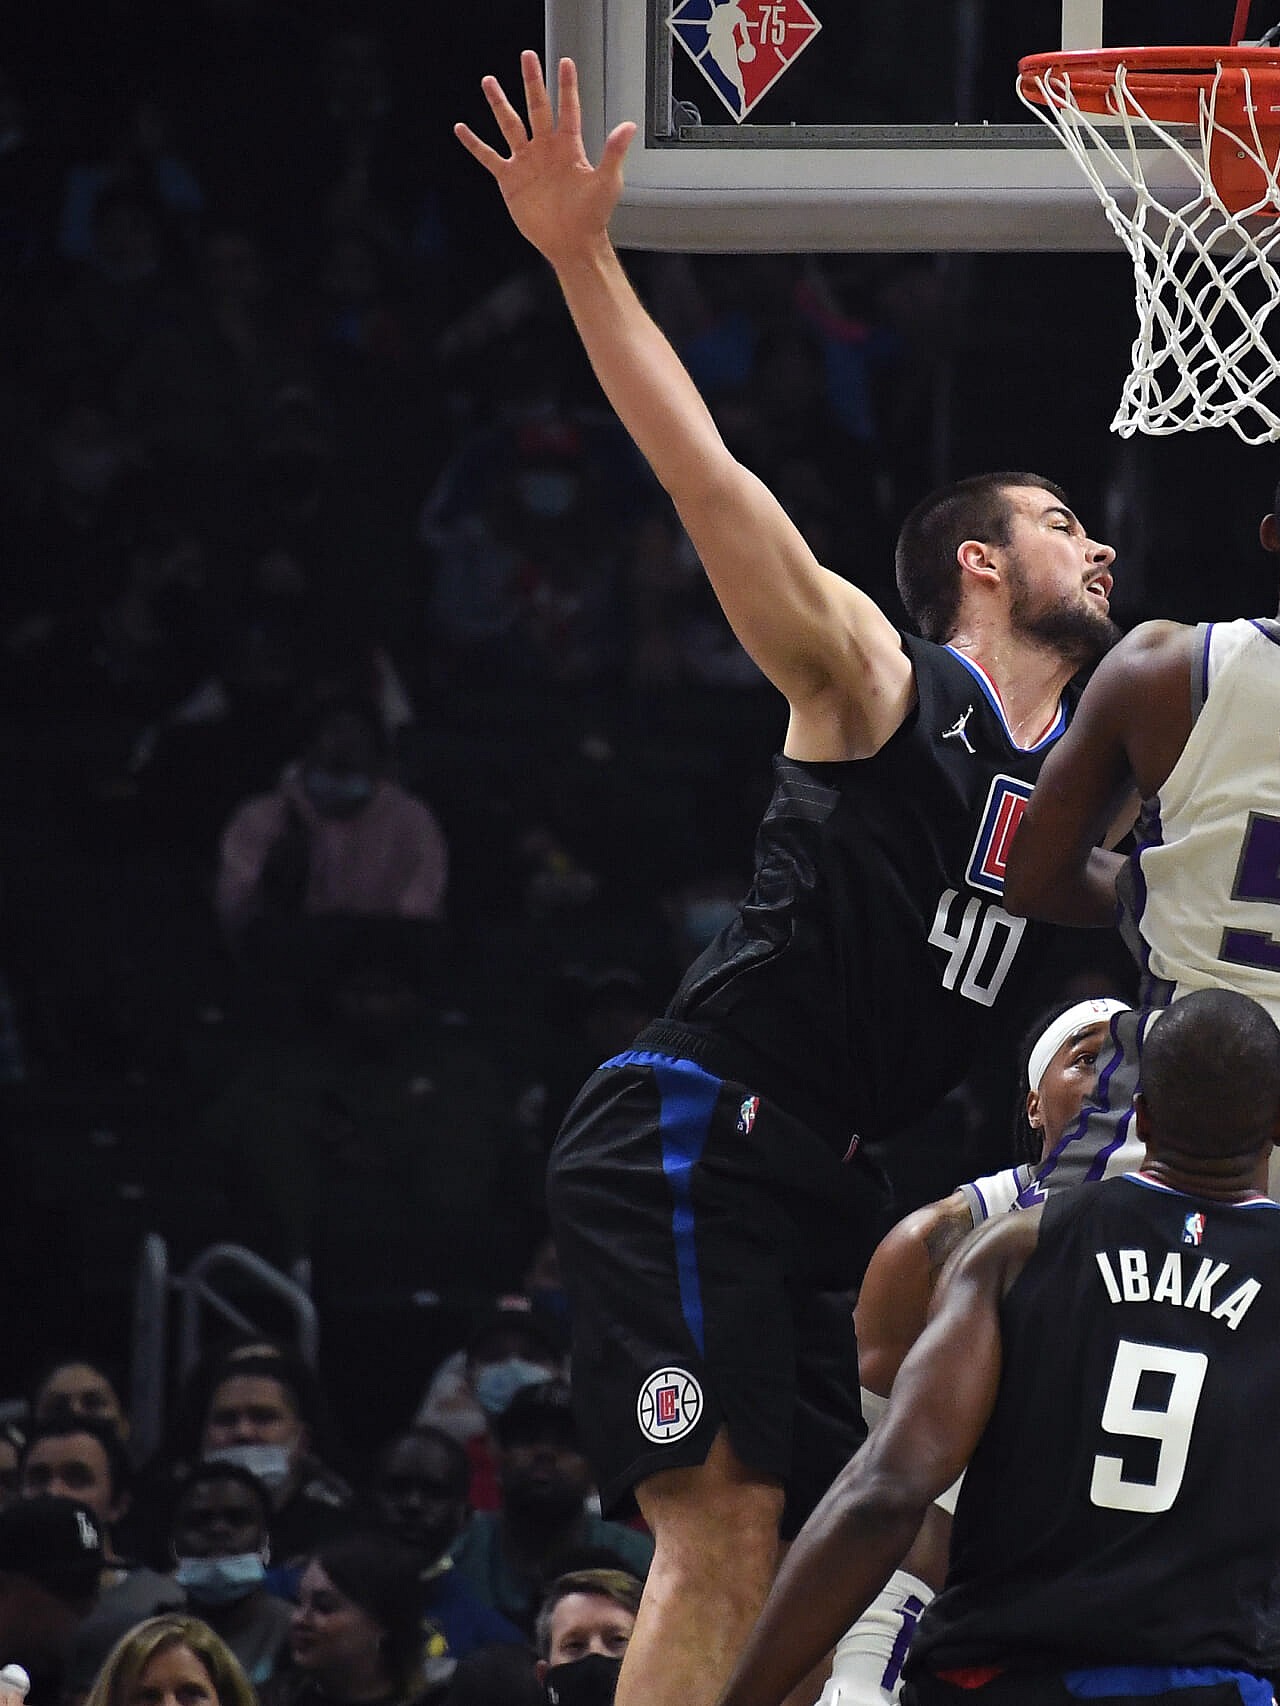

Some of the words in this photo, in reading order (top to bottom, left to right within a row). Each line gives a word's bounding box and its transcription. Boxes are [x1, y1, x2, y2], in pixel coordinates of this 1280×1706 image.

[758, 5, 787, 46] 75
[927, 887, 1028, 1008] 40
[1095, 1249, 1263, 1332] IBAKA
[1089, 1339, 1209, 1514] 9
